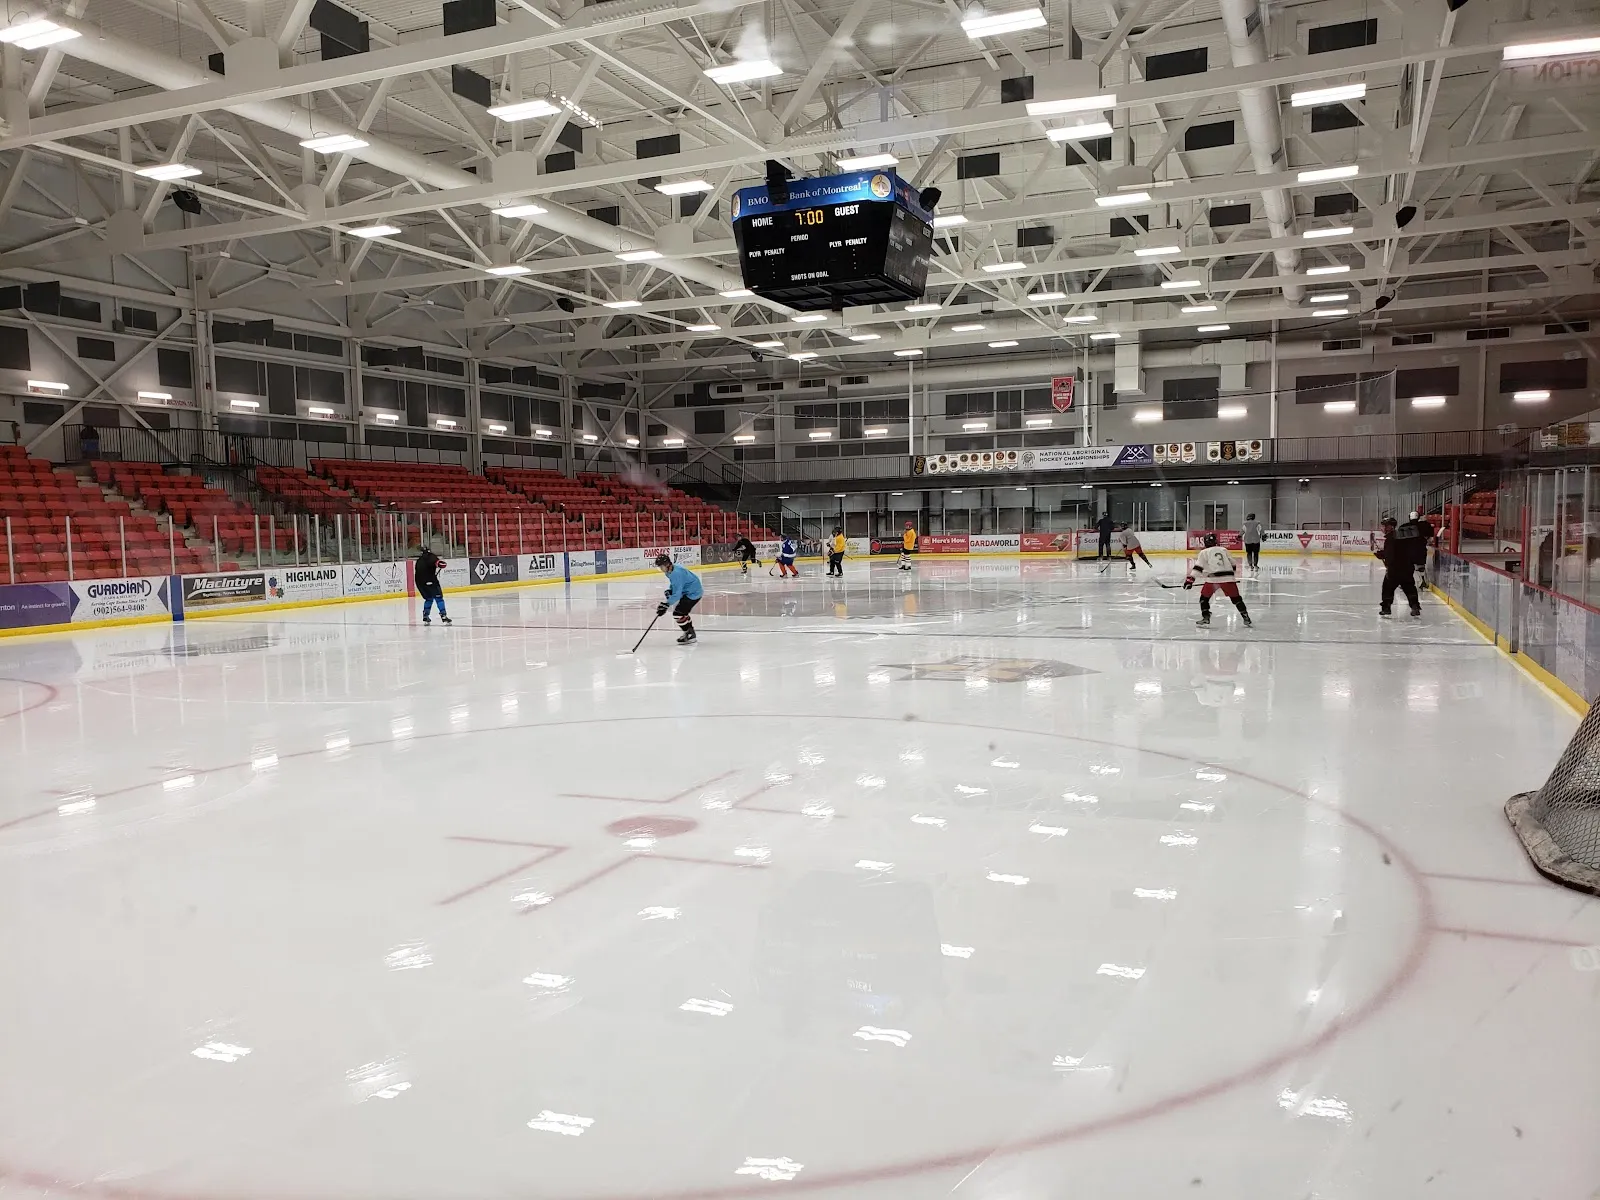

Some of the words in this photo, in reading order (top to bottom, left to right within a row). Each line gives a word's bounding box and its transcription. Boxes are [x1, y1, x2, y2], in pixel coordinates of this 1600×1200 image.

[747, 197, 768, 206] BMO
[789, 190, 811, 200] Bank
[812, 189, 821, 197] of
[822, 183, 862, 195] Montreal
[834, 205, 860, 217] GUEST
[752, 217, 773, 227] HOME
[795, 210, 824, 225] 7:00
[790, 234, 809, 242] PERIOD
[829, 240, 842, 248] PLYR
[845, 237, 868, 246] PENALTY
[764, 248, 785, 256] PENALTY
[815, 271, 829, 279] GOAL
[970, 539, 1020, 547] GARDAWORLD
[1214, 552, 1225, 566] 3
[286, 569, 337, 583] HIGHLAND
[87, 579, 152, 599] GUARDIAN
[192, 577, 263, 590] MacIntyre
[0, 603, 15, 611] nton
[51, 601, 66, 609] growth
[93, 603, 145, 616] (902)564-9408
